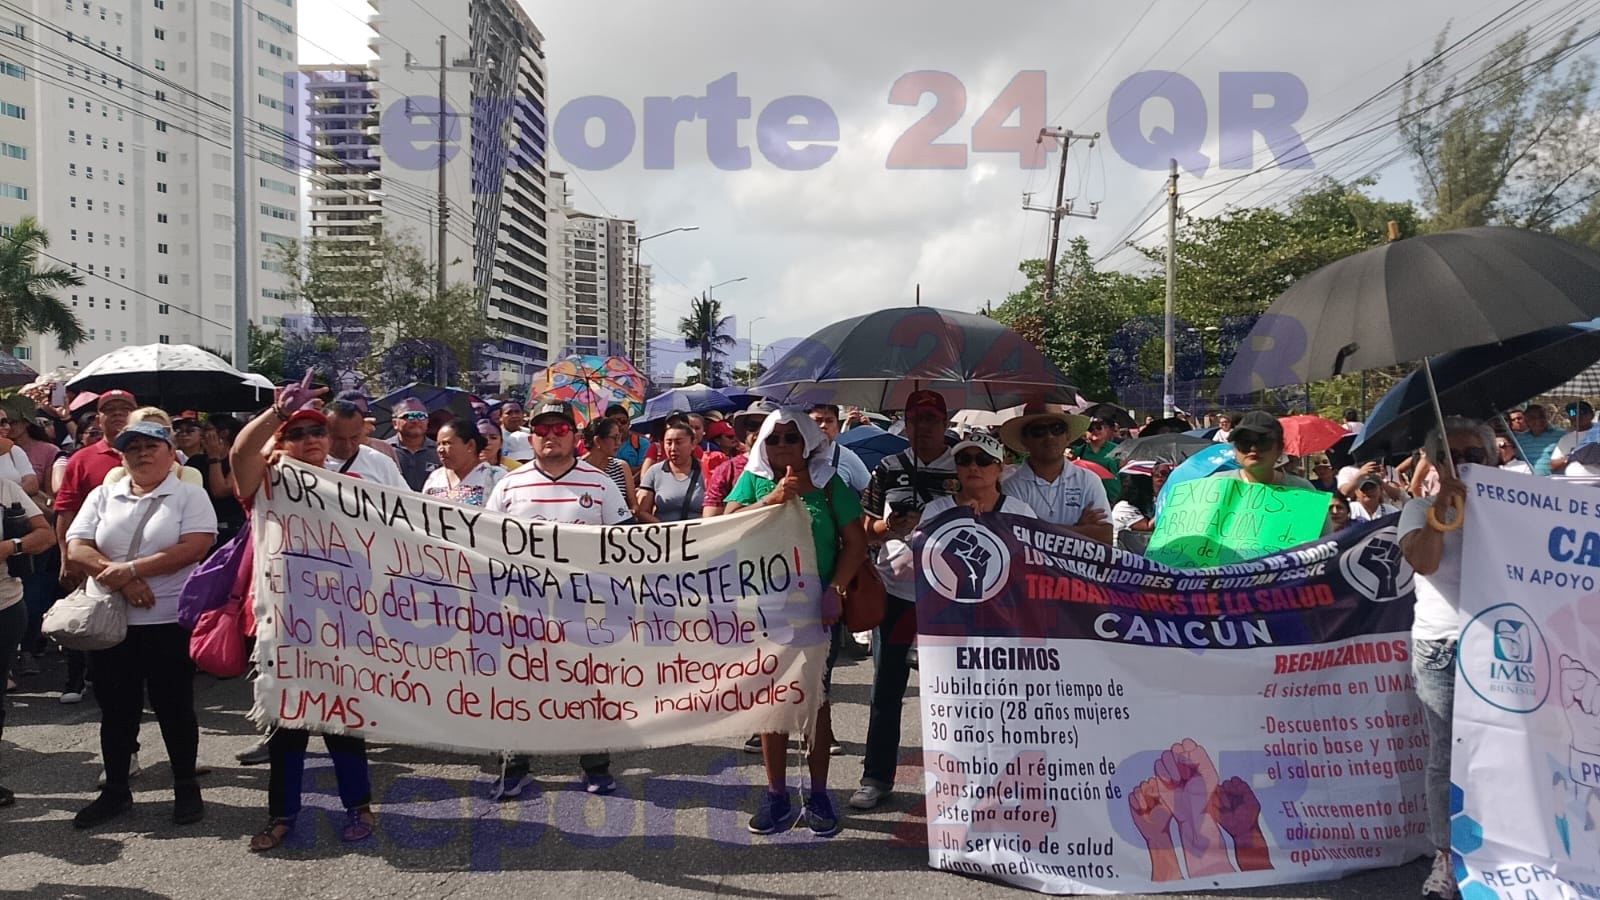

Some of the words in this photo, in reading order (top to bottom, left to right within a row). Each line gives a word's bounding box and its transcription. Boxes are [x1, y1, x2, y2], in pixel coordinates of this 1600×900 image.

[1477, 483, 1562, 511] PERSONAL
[1569, 499, 1588, 515] DE
[338, 482, 414, 532] UNA
[422, 501, 483, 548] LEY
[501, 518, 569, 564] DEL
[598, 522, 702, 564] ISSSTE
[265, 511, 351, 564] DIGNA
[355, 528, 376, 569] Y
[386, 538, 477, 590] JUSTA
[489, 557, 562, 598] PARA
[570, 572, 606, 604] EL
[1013, 525, 1031, 545] EN
[1034, 531, 1105, 563] DEFENSA
[1111, 550, 1144, 570] POR
[1287, 541, 1338, 566] TODOS
[1024, 546, 1051, 566] LOS
[1049, 555, 1171, 590] TRABAJADORES
[1176, 577, 1209, 591] QUE
[1212, 572, 1278, 589] COTIZAN
[1506, 564, 1524, 581] EN
[1530, 571, 1594, 591] APOYO
[269, 557, 292, 593] El
[302, 568, 378, 616] sueldo
[382, 583, 418, 621] del
[430, 590, 571, 649] trabajador
[585, 615, 615, 645] es
[1026, 574, 1187, 614] TRABAJADORES
[1192, 593, 1219, 615] DE
[1223, 591, 1251, 612] LA
[1253, 583, 1335, 611] SALUD
[1094, 612, 1273, 645] CANCÚN
[274, 604, 312, 643] No
[321, 611, 346, 650] al
[356, 620, 497, 676] descuento
[508, 647, 549, 682] del
[556, 653, 644, 687] salario
[657, 648, 779, 693] integrado
[956, 646, 1060, 670] EXIGIMOS
[1274, 641, 1409, 674] RECHAZAMOS
[276, 645, 431, 706] Eliminación
[447, 680, 482, 717] de
[490, 687, 531, 721] las
[539, 690, 638, 721] cuentas
[654, 678, 805, 714] individuales
[1490, 662, 1536, 684] IMSS
[1026, 681, 1051, 701] por
[1055, 679, 1102, 699] tiempo
[1107, 679, 1124, 696] de
[1281, 681, 1342, 697] sistema
[1349, 682, 1368, 695] en
[279, 688, 378, 728] UMAS.
[930, 701, 994, 719] servicio
[1000, 701, 1027, 724] (28
[1034, 702, 1070, 720] años
[1074, 704, 1130, 725] mujeres
[1365, 710, 1410, 729] sobre
[1413, 710, 1424, 726] el
[931, 722, 947, 741] 30
[954, 725, 994, 743] años
[1002, 725, 1079, 748] hombres)
[1264, 738, 1318, 757] salario
[1324, 736, 1363, 755] base
[1369, 739, 1380, 757] y
[1387, 737, 1404, 751] no
[1408, 729, 1430, 748] sob
[1006, 757, 1021, 775] al
[1028, 758, 1094, 781] régimen
[1099, 756, 1116, 775] de
[1268, 761, 1282, 780] el
[1287, 760, 1342, 779] salario
[1349, 754, 1424, 779] integrado
[1105, 780, 1122, 799] de
[937, 803, 996, 822] sistema
[1003, 805, 1057, 829] afore)
[1303, 800, 1392, 819] incremento
[1398, 794, 1418, 815] del
[1286, 821, 1355, 841] adicional
[1360, 825, 1369, 840] a
[1374, 820, 1430, 839] nuestra
[966, 834, 1031, 853] servicio
[1039, 837, 1059, 855] de
[1067, 837, 1113, 856] salud
